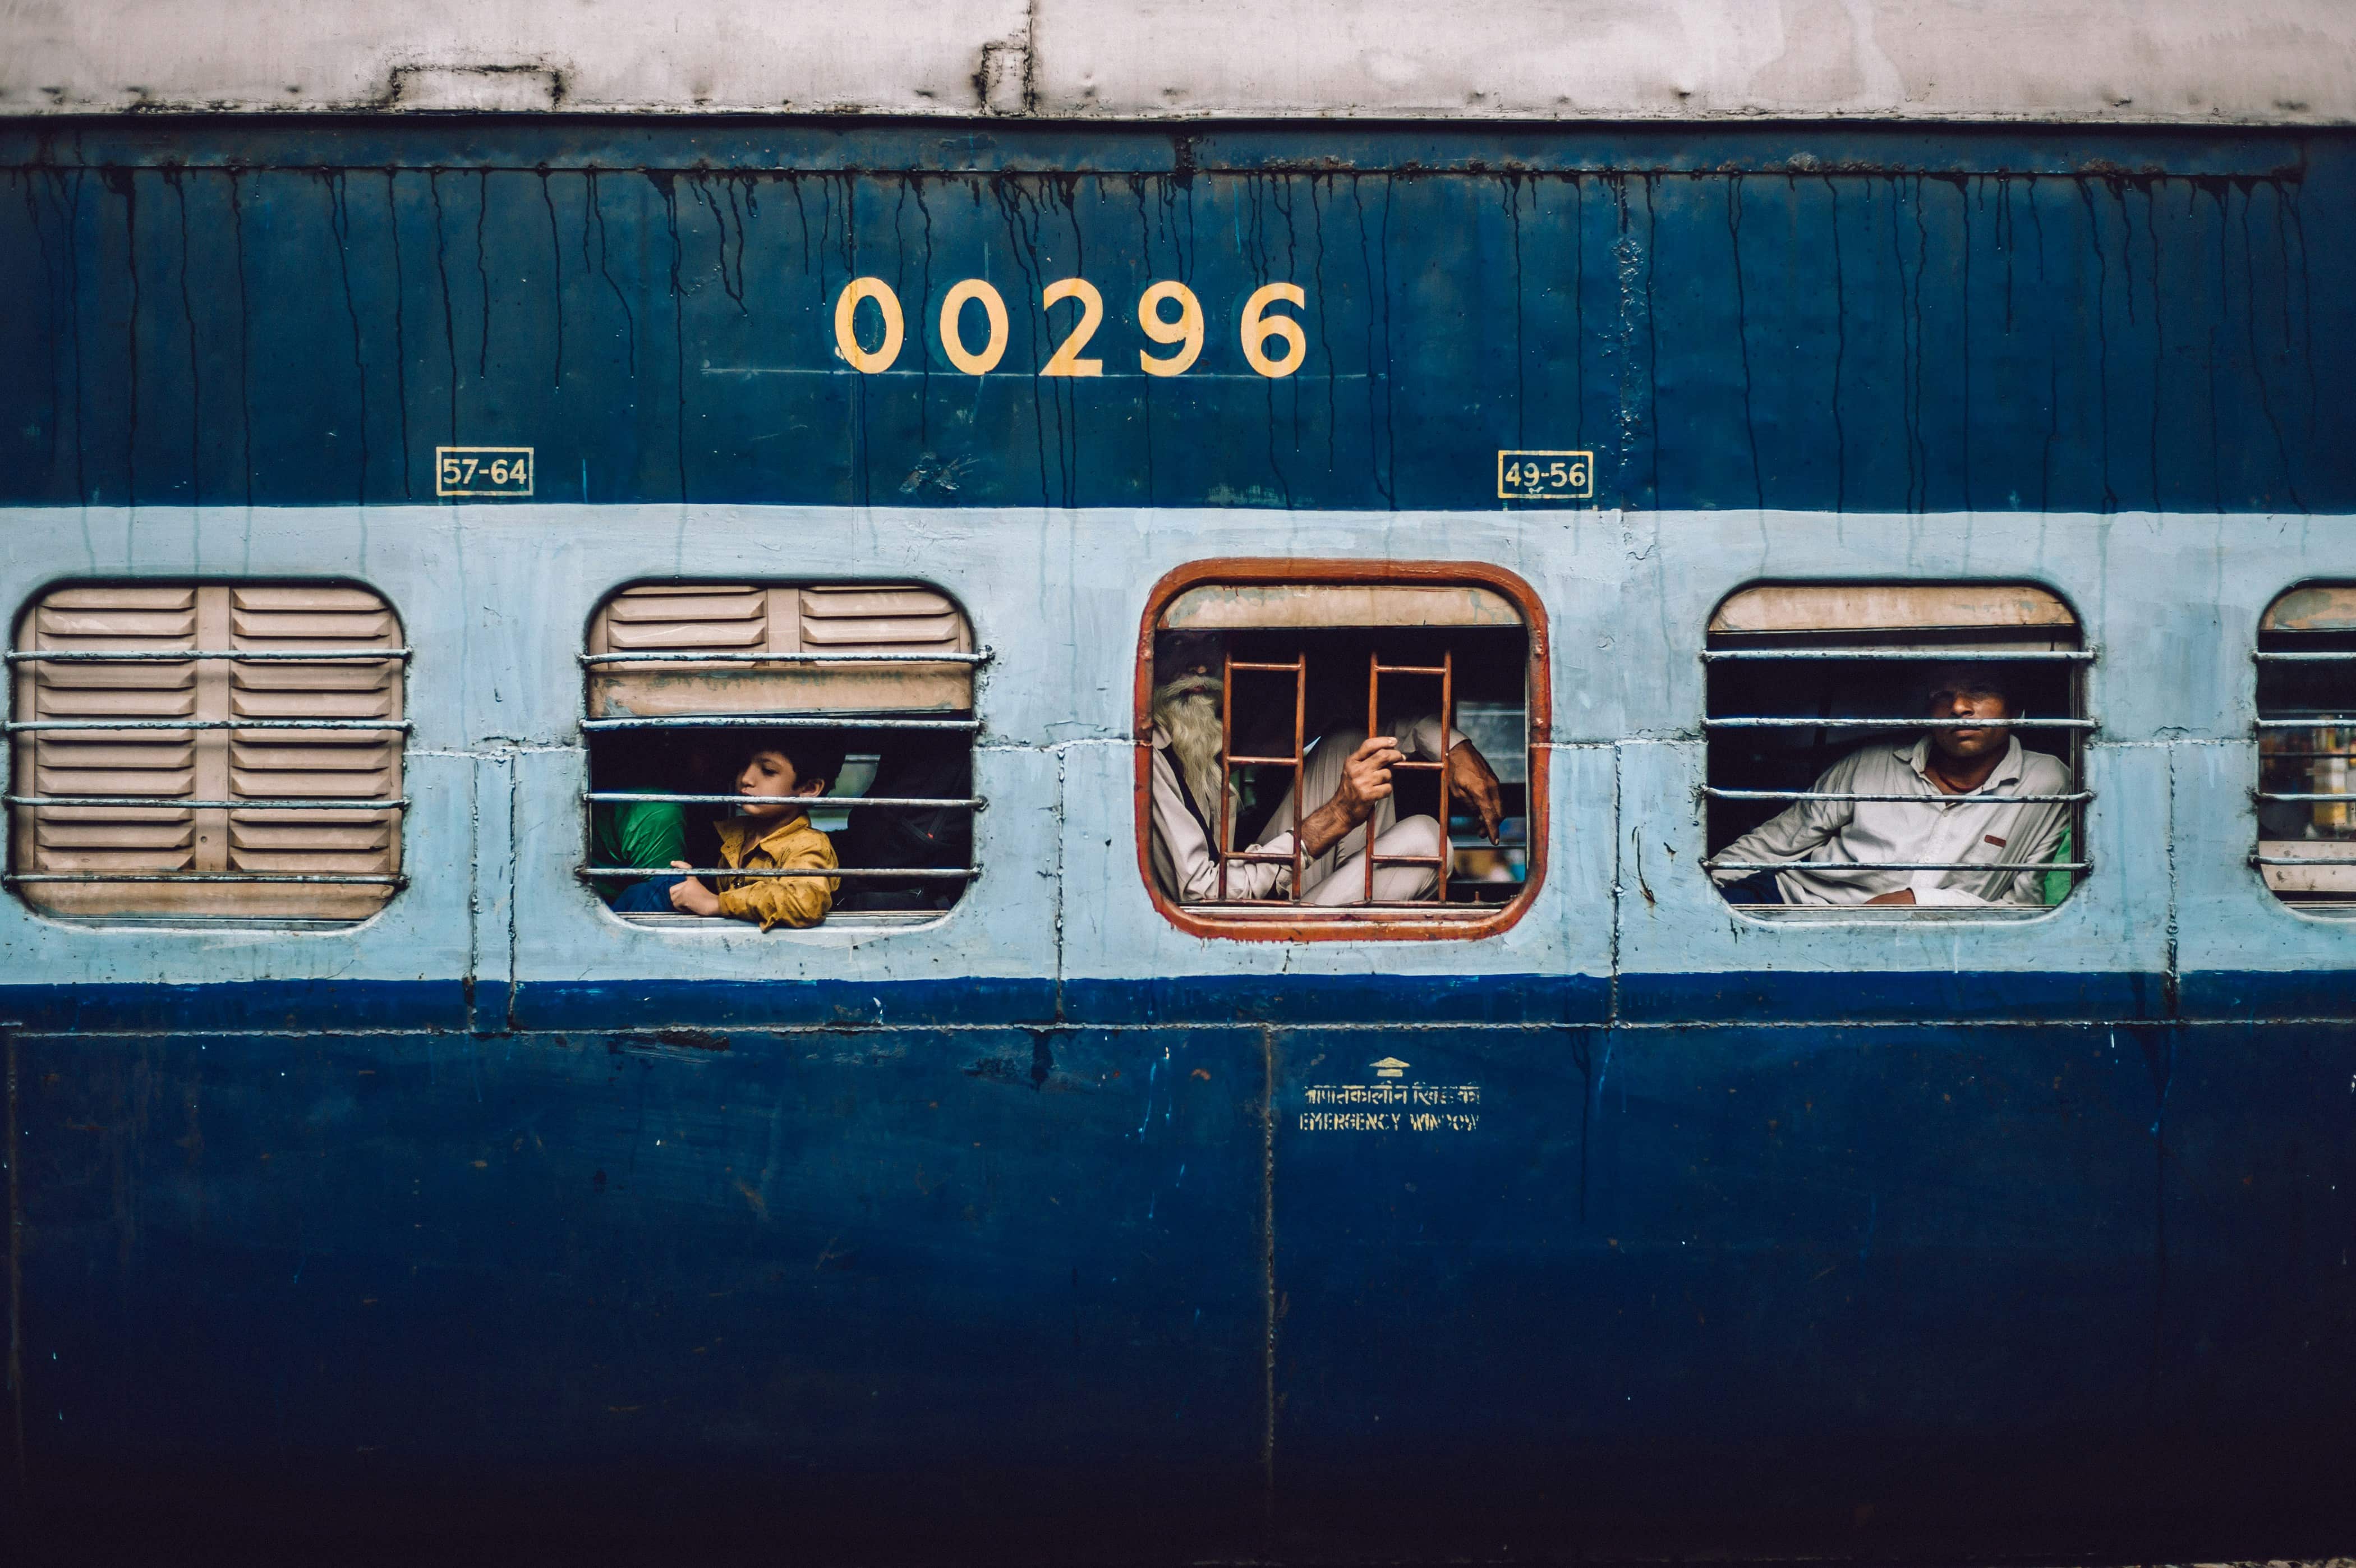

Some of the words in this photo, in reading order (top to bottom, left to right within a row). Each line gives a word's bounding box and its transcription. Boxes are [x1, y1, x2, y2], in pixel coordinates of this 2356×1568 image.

[835, 277, 1306, 378] 00296
[443, 458, 527, 484] 57-64
[1505, 462, 1586, 487] 49-56
[1300, 1112, 1401, 1131] EMERGENCY
